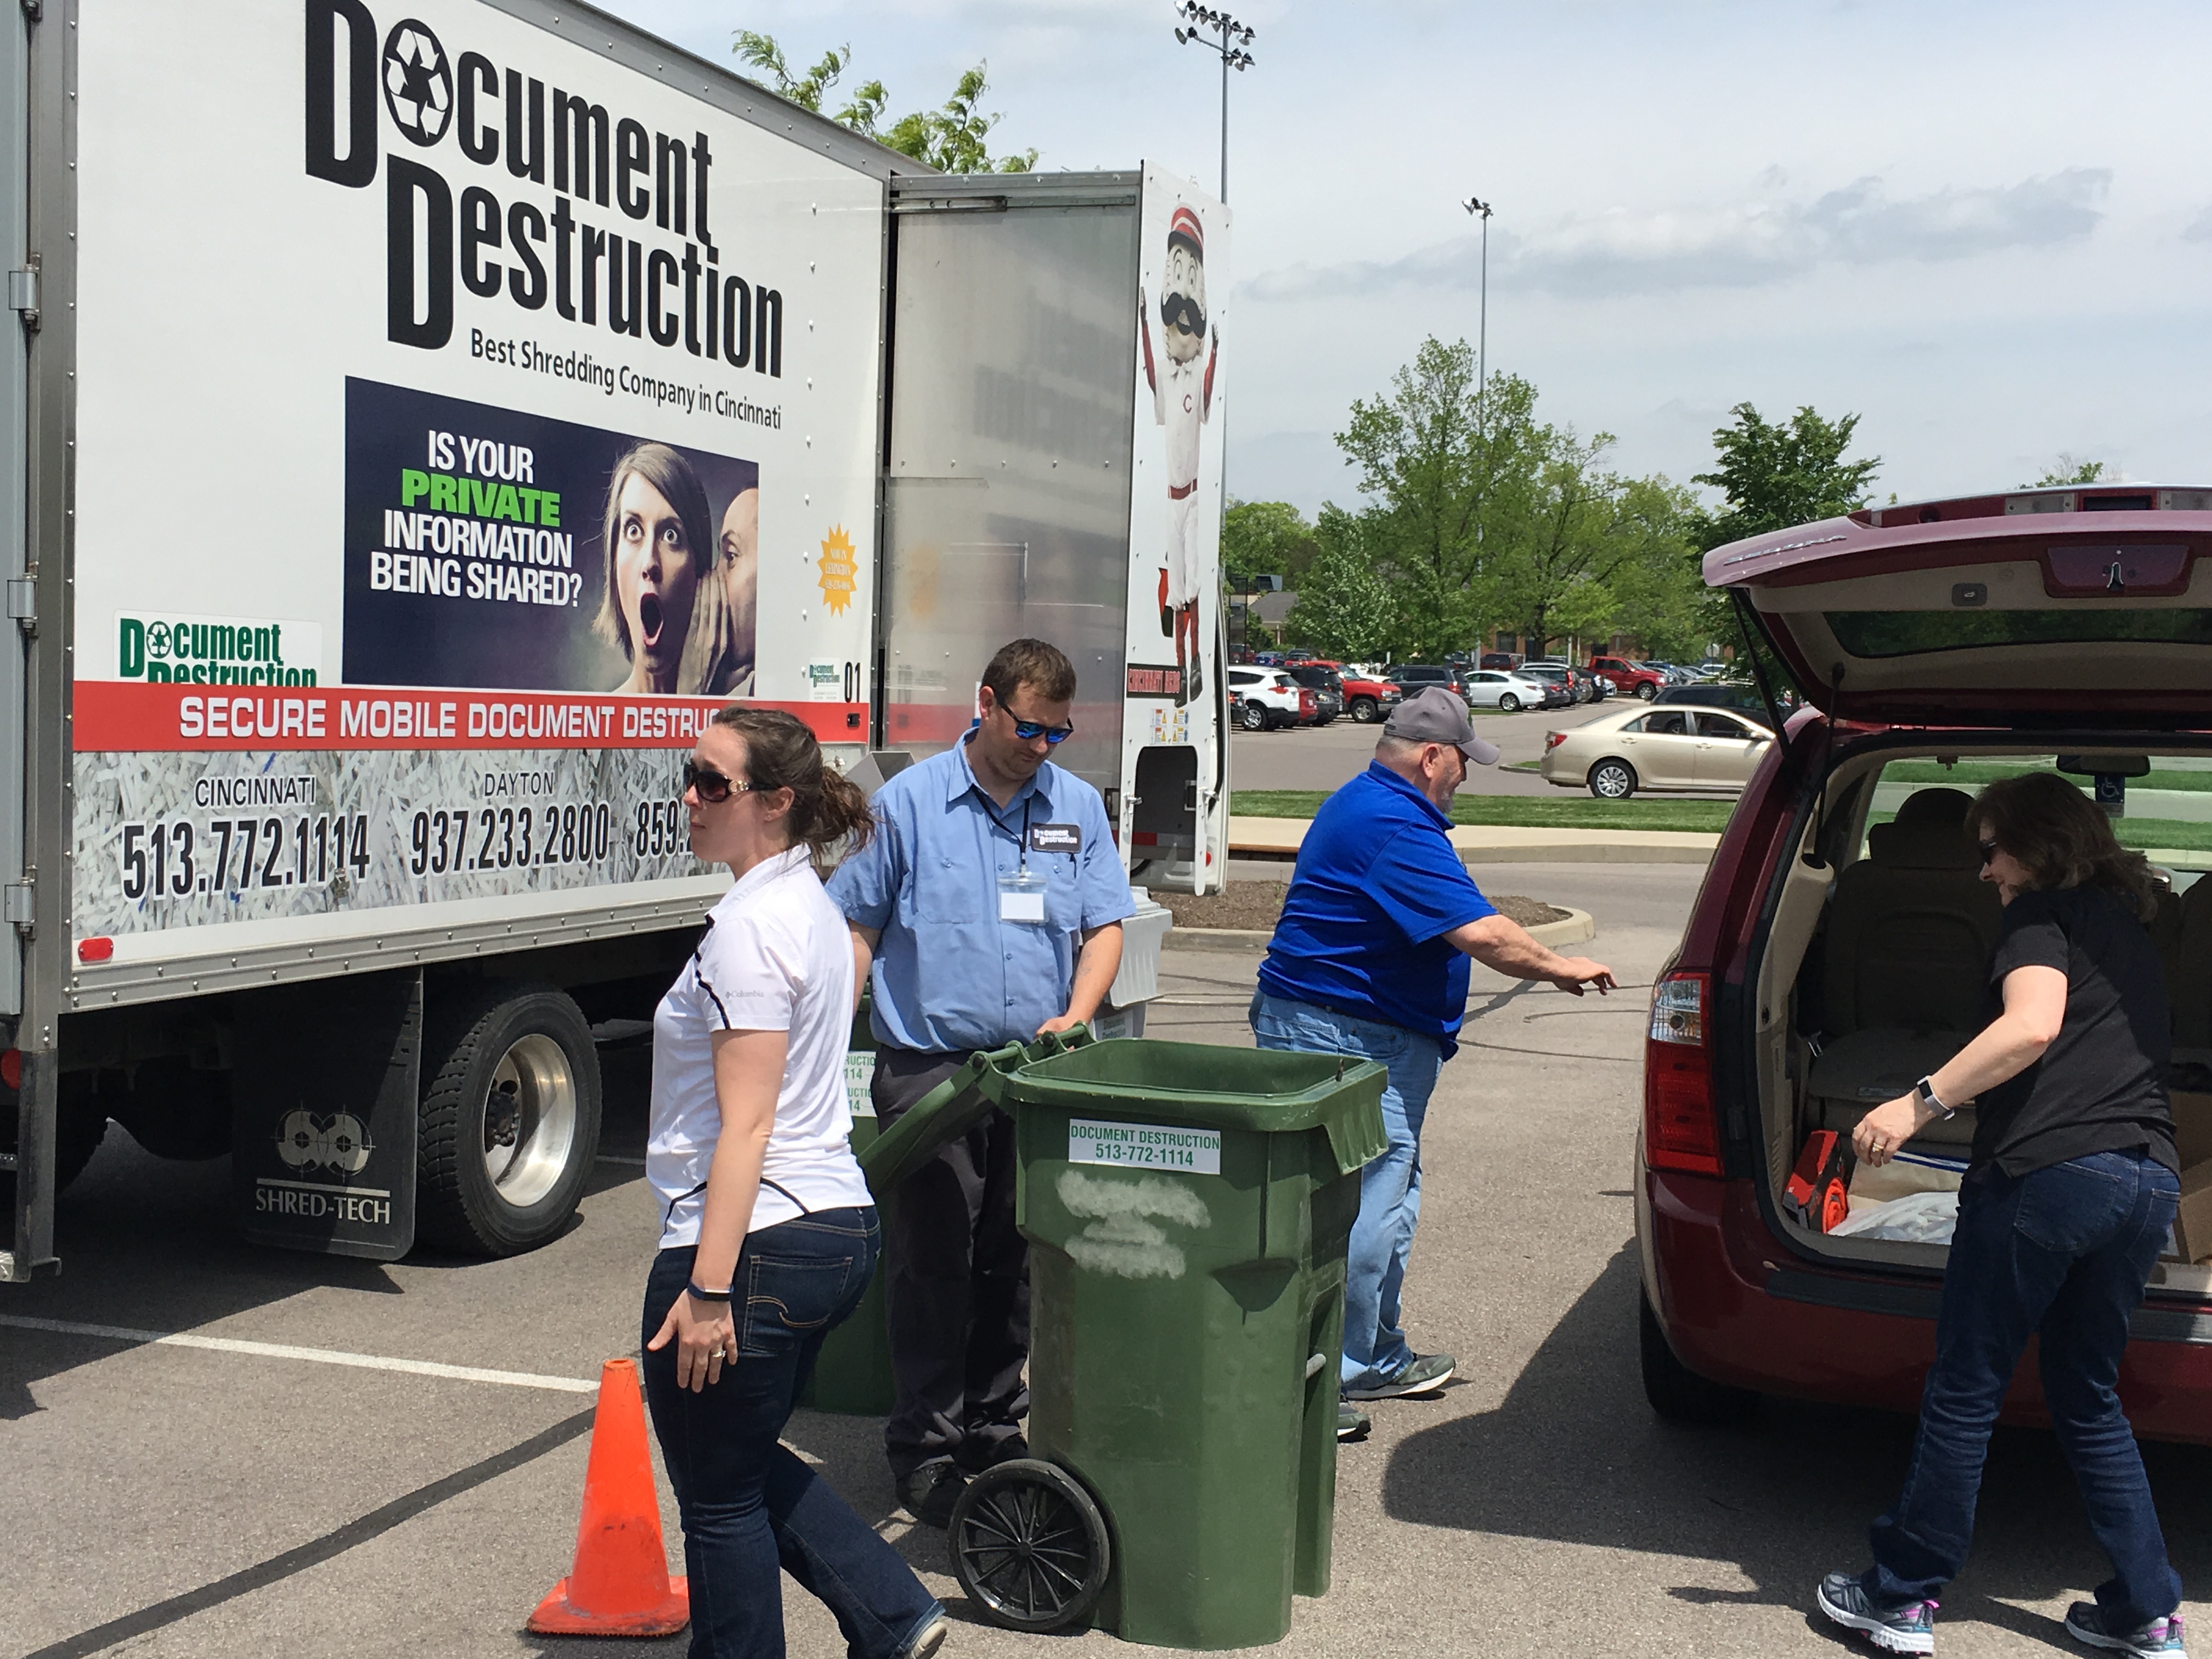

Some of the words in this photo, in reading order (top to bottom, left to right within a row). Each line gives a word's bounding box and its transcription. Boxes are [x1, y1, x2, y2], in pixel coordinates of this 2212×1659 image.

[387, 153, 782, 379] Destruction
[471, 328, 516, 366] Best
[522, 340, 614, 396] Shredding
[619, 365, 695, 415] Company
[699, 384, 712, 413] in
[715, 391, 781, 430] Cincinnati
[428, 430, 455, 470] IS
[459, 435, 534, 484] YOUR
[402, 468, 560, 527] PRIVATE
[385, 509, 573, 568] INFORMATION
[370, 551, 461, 597] BEING
[466, 561, 583, 607] SHARED?
[845, 662, 861, 703] 01
[180, 696, 326, 738] SECURE
[340, 700, 457, 738] MOBILE
[468, 703, 615, 738] DOCUMENT
[195, 776, 315, 807] CINCINNATI
[484, 771, 554, 797] DAYTON
[411, 803, 610, 874] 937.233.2800
[635, 800, 691, 858] 859.
[123, 814, 371, 899] 513.772.1114
[731, 990, 764, 998] Columbia
[1071, 1125, 1136, 1142] DOCUMENT
[1139, 1131, 1220, 1150] DESTRUCTION
[1095, 1143, 1194, 1166] 513-772-1114
[255, 1188, 390, 1224] SHRED-TECH
